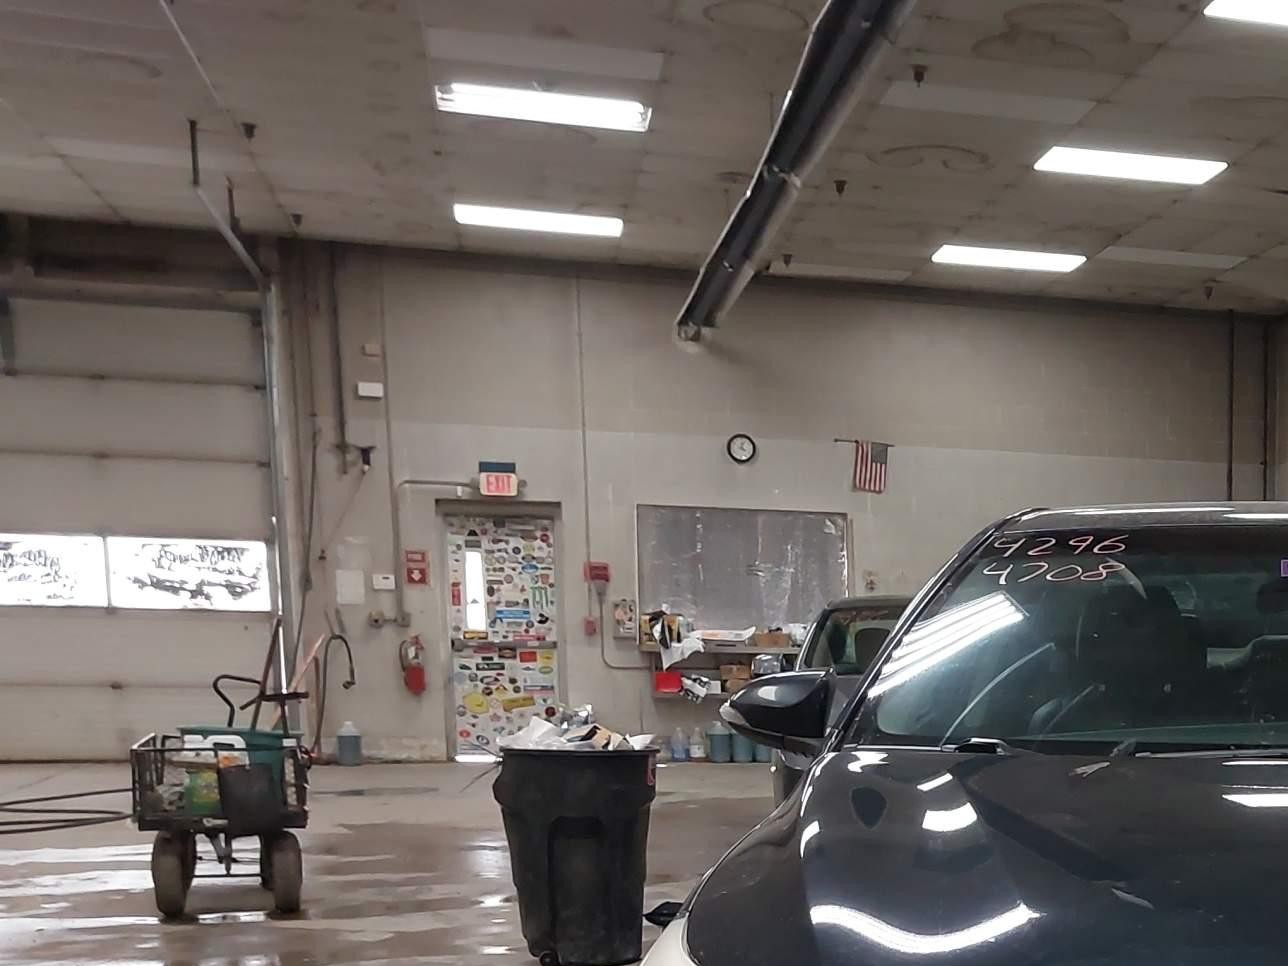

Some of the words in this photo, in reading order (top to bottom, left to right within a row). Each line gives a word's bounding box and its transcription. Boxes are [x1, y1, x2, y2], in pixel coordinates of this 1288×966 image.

[486, 474, 513, 494] EXIT
[994, 534, 1129, 557] 4296
[983, 560, 1126, 585] 4708
